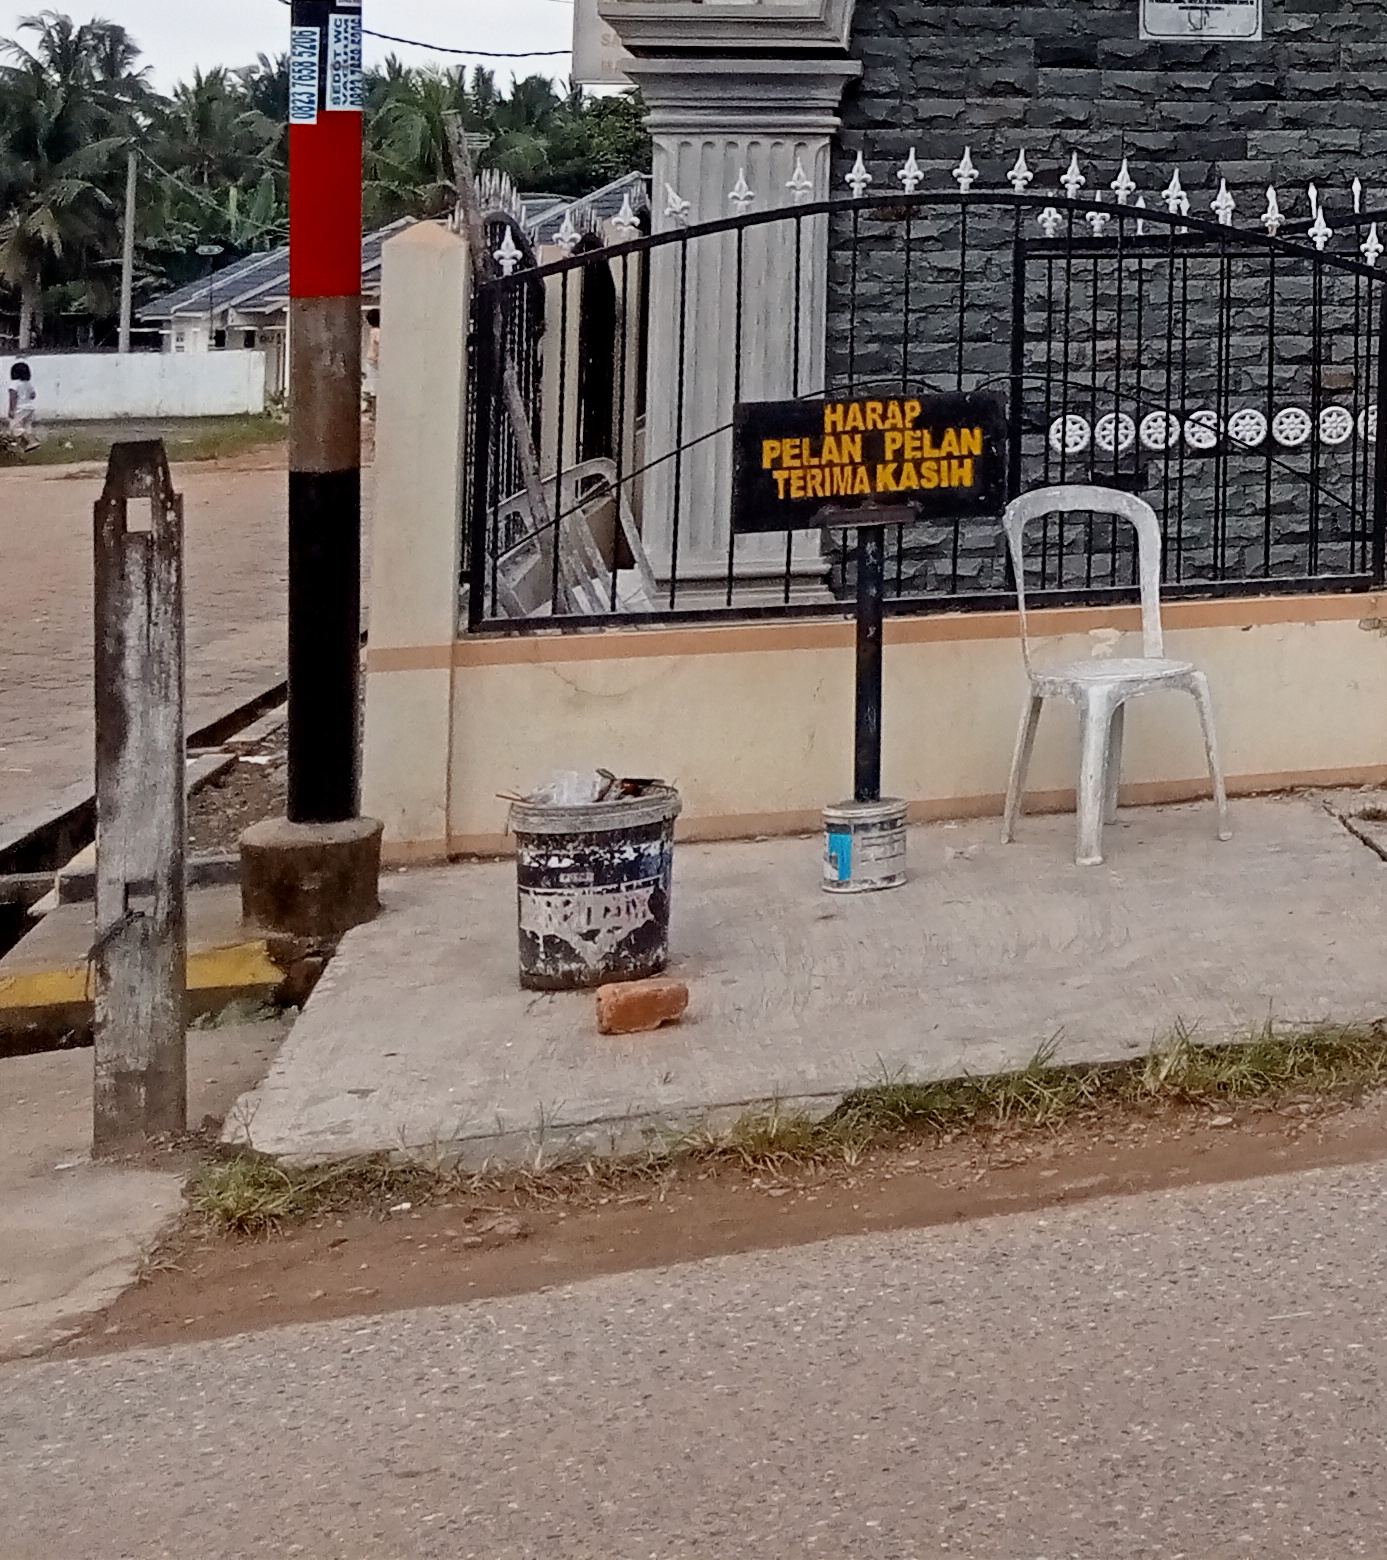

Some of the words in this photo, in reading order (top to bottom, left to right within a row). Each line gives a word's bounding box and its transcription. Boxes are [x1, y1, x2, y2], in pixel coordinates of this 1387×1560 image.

[291, 30, 318, 58] 5206
[334, 18, 343, 44] WC
[291, 61, 317, 88] 7658
[333, 49, 342, 106] SEDOT
[291, 91, 316, 119] 0823
[824, 399, 922, 433] HARAP
[762, 433, 862, 469] PELAN
[884, 427, 982, 461] PELAN
[772, 465, 870, 499] TERIMA
[876, 458, 974, 492] KASIH
